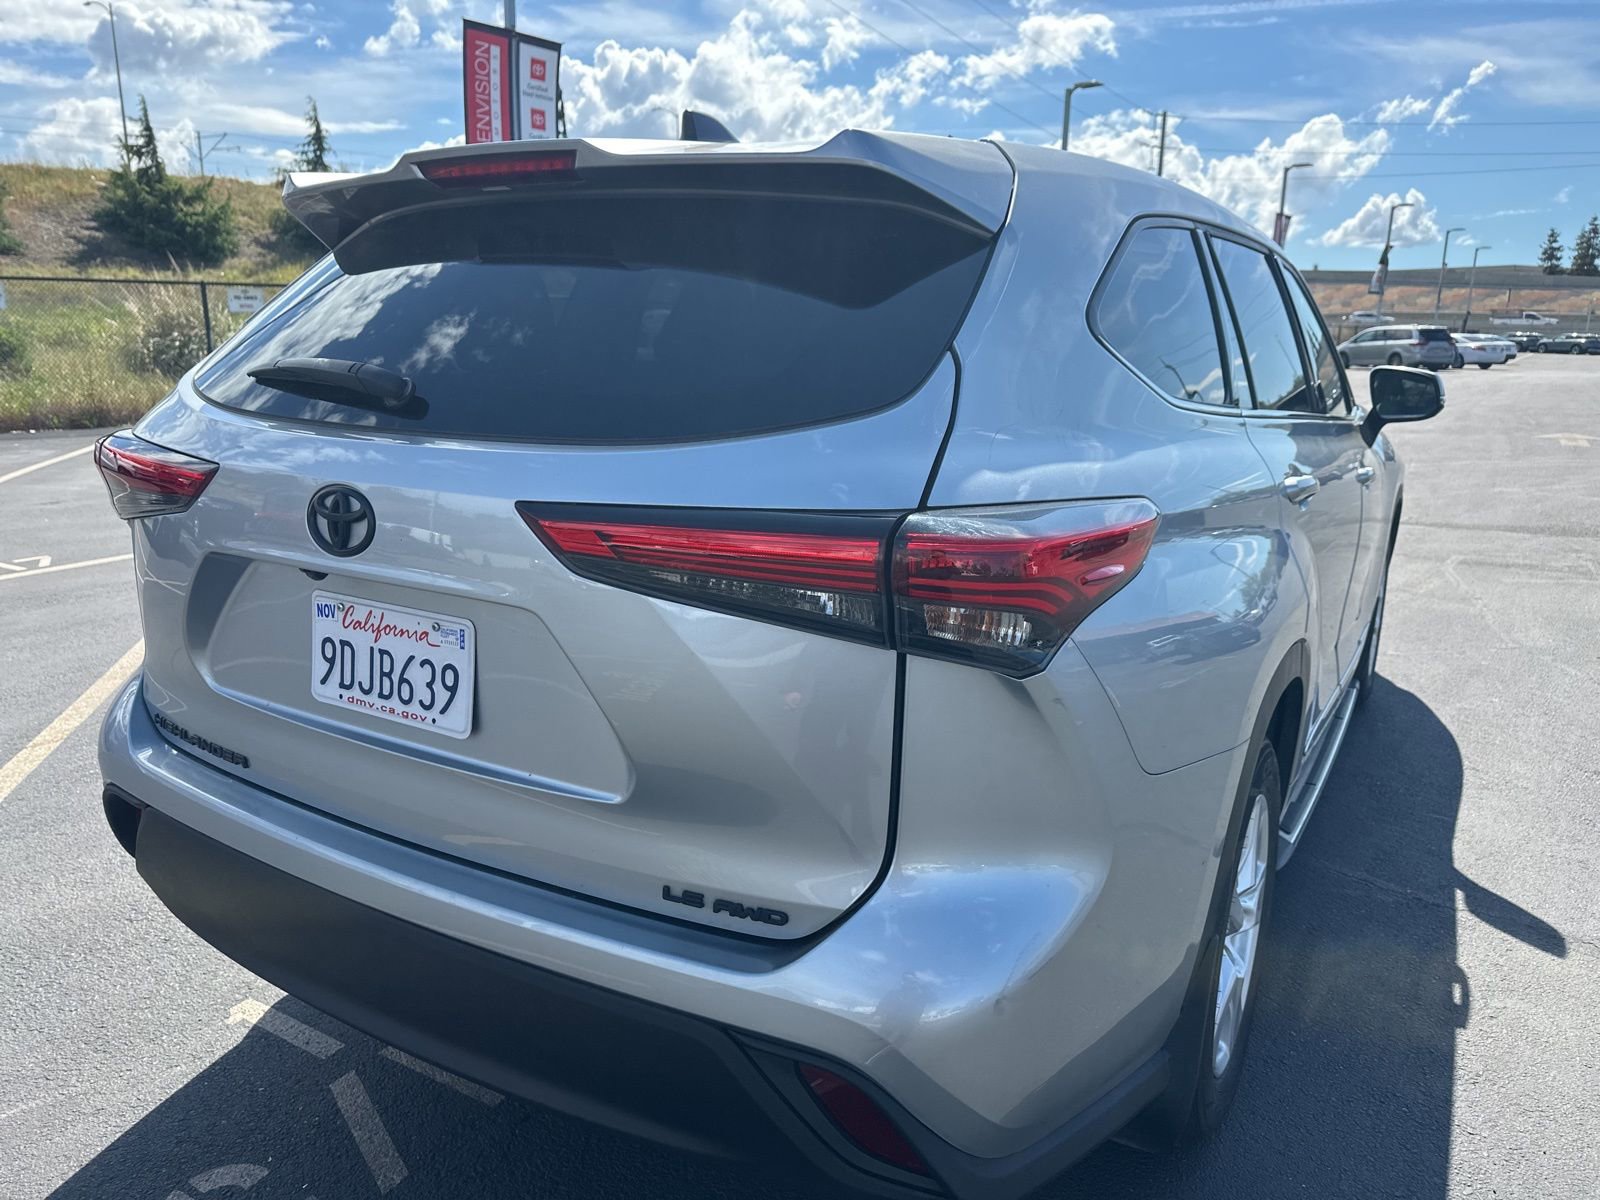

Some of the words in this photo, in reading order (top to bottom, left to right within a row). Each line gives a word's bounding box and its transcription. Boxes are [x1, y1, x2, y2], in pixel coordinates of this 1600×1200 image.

[474, 40, 492, 142] ENVISION
[316, 603, 336, 619] NOV
[341, 604, 441, 648] California
[320, 636, 460, 715] 9DJB639
[347, 695, 428, 722] dmv.ca.gov
[154, 712, 251, 769] HIGHLANDER
[662, 884, 705, 909] LE
[713, 898, 789, 926] AWD
